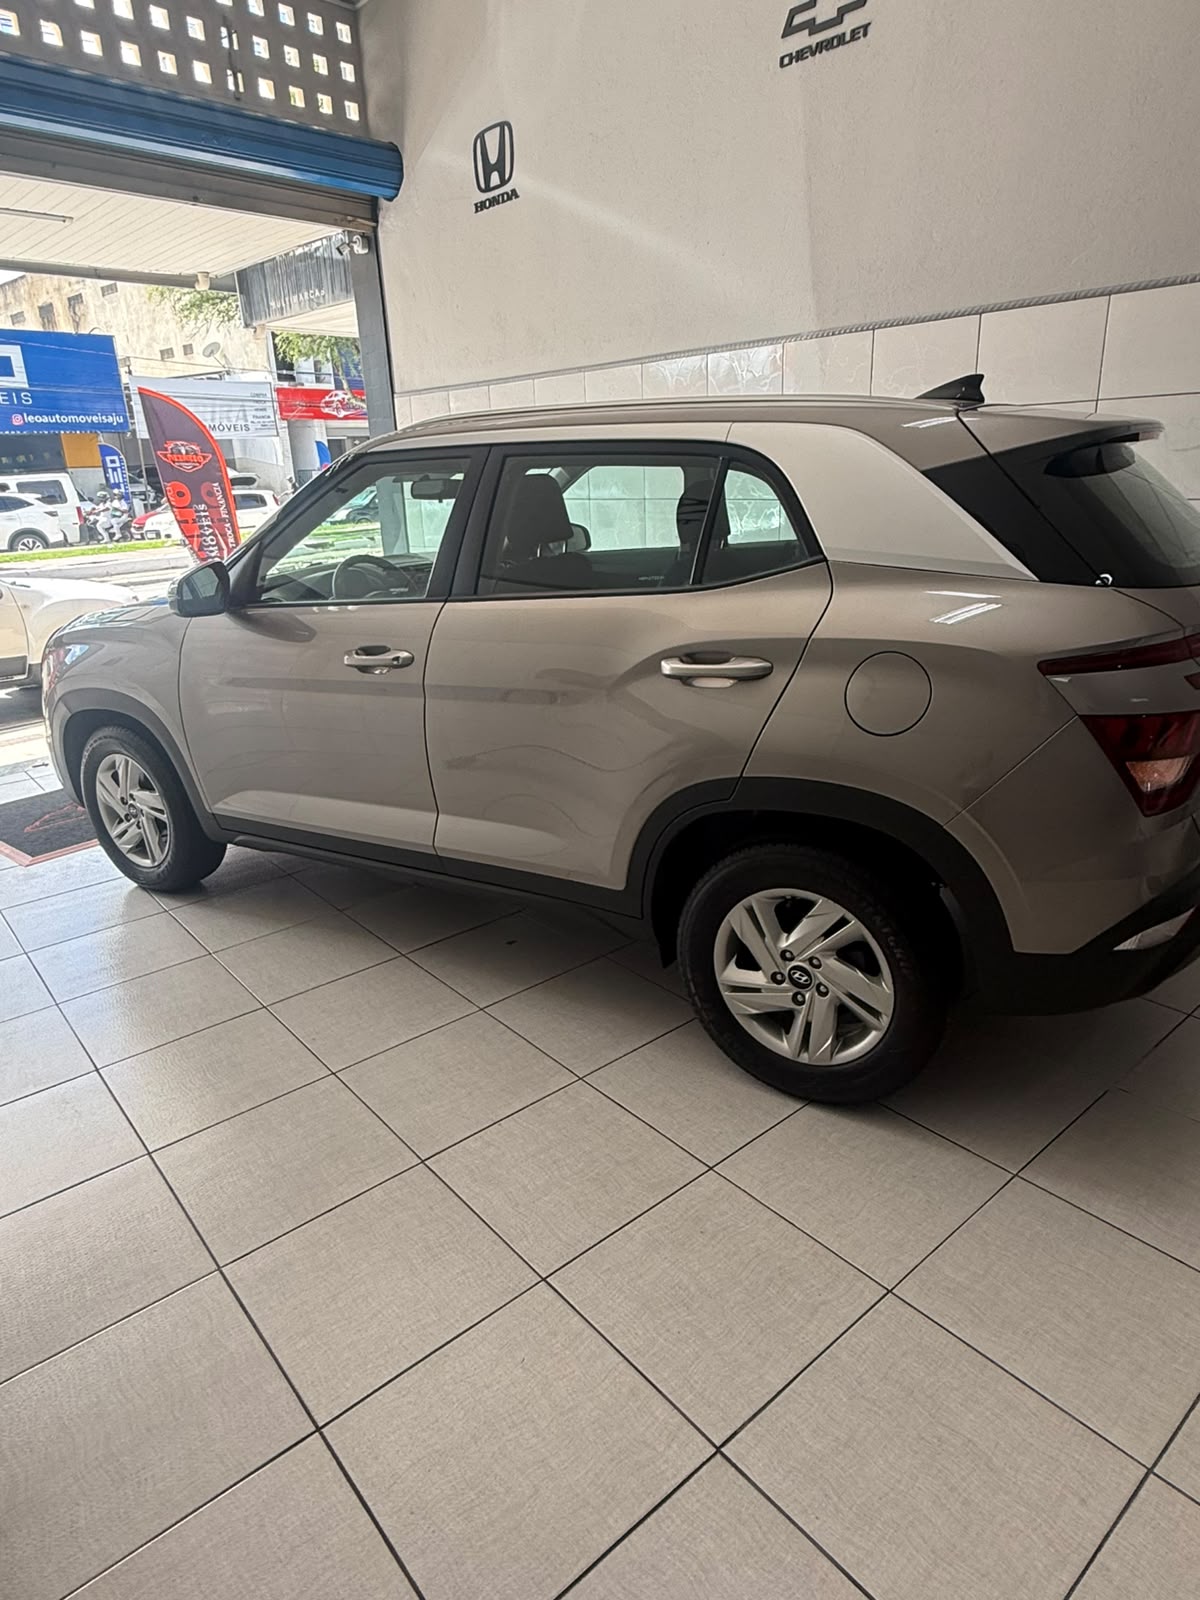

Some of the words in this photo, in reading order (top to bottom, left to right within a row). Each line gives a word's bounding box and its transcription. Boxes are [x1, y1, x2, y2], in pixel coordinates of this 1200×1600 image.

[779, 21, 872, 69] CHEVROLET
[473, 187, 520, 214] HONDA
[23, 412, 124, 425] leoautomoveisaju
[223, 522, 237, 549] TROCA
